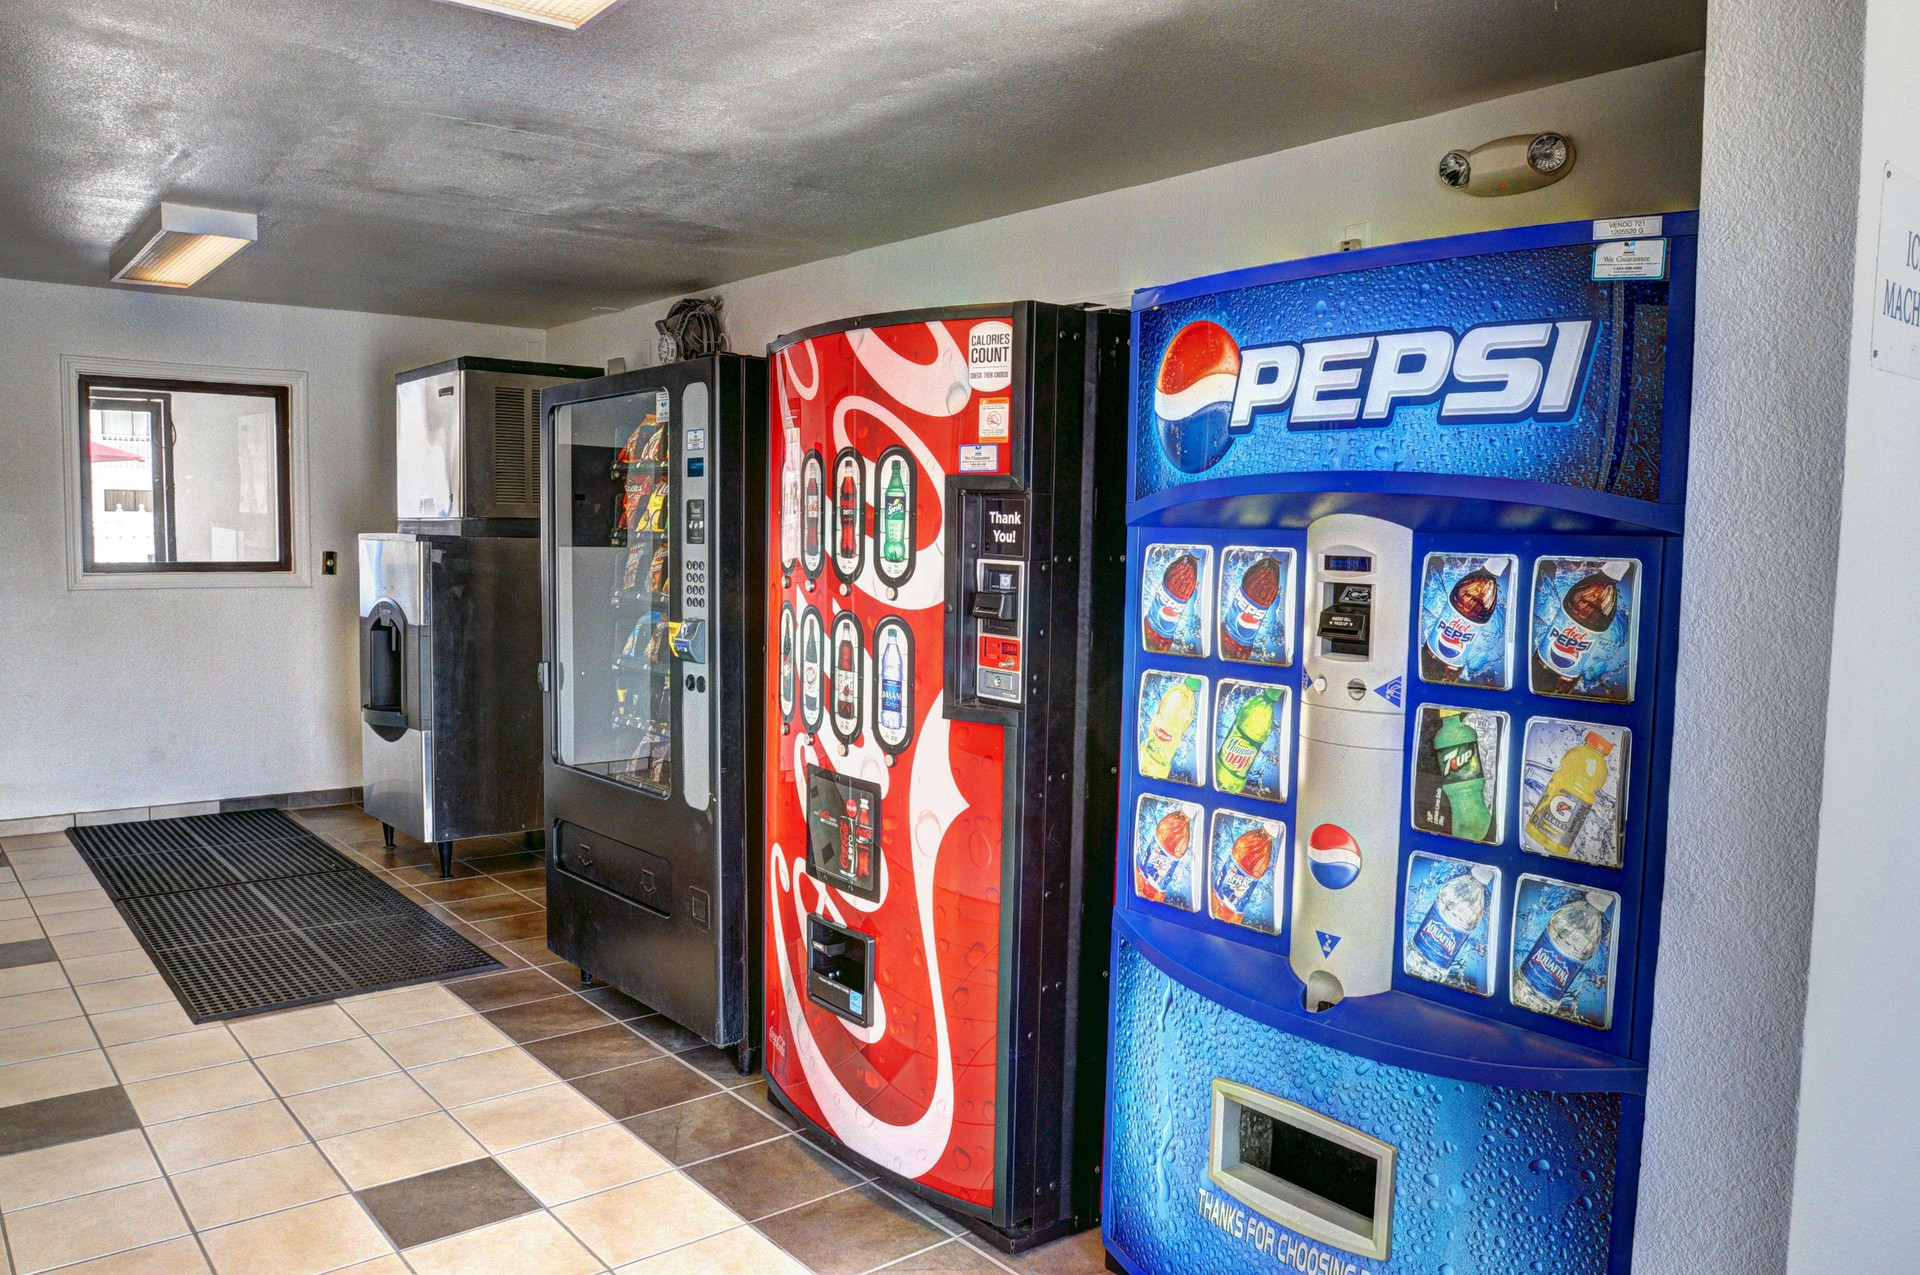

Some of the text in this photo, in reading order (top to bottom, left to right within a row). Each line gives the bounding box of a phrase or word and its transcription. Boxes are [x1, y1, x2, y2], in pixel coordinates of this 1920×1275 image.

[1609, 220, 1633, 228] VENDO
[1616, 255, 1651, 263] Guarantee
[1906, 230, 1920, 271] IC
[971, 333, 1010, 347] CALORIES
[971, 347, 1009, 364] COUNT
[983, 371, 993, 379] THEN
[1228, 319, 1595, 427] PEPSI
[989, 510, 1021, 525] Thank
[993, 529, 1016, 543] You!
[1437, 618, 1475, 642] PEPSI
[1449, 617, 1474, 635] diet
[1562, 625, 1590, 641] diet
[1550, 626, 1593, 651] PEPSI
[1421, 921, 1457, 955] AQUAFINA
[1531, 949, 1570, 987] AQUAFINA
[1198, 1188, 1245, 1239] THANKS
[1245, 1217, 1275, 1256] FOR
